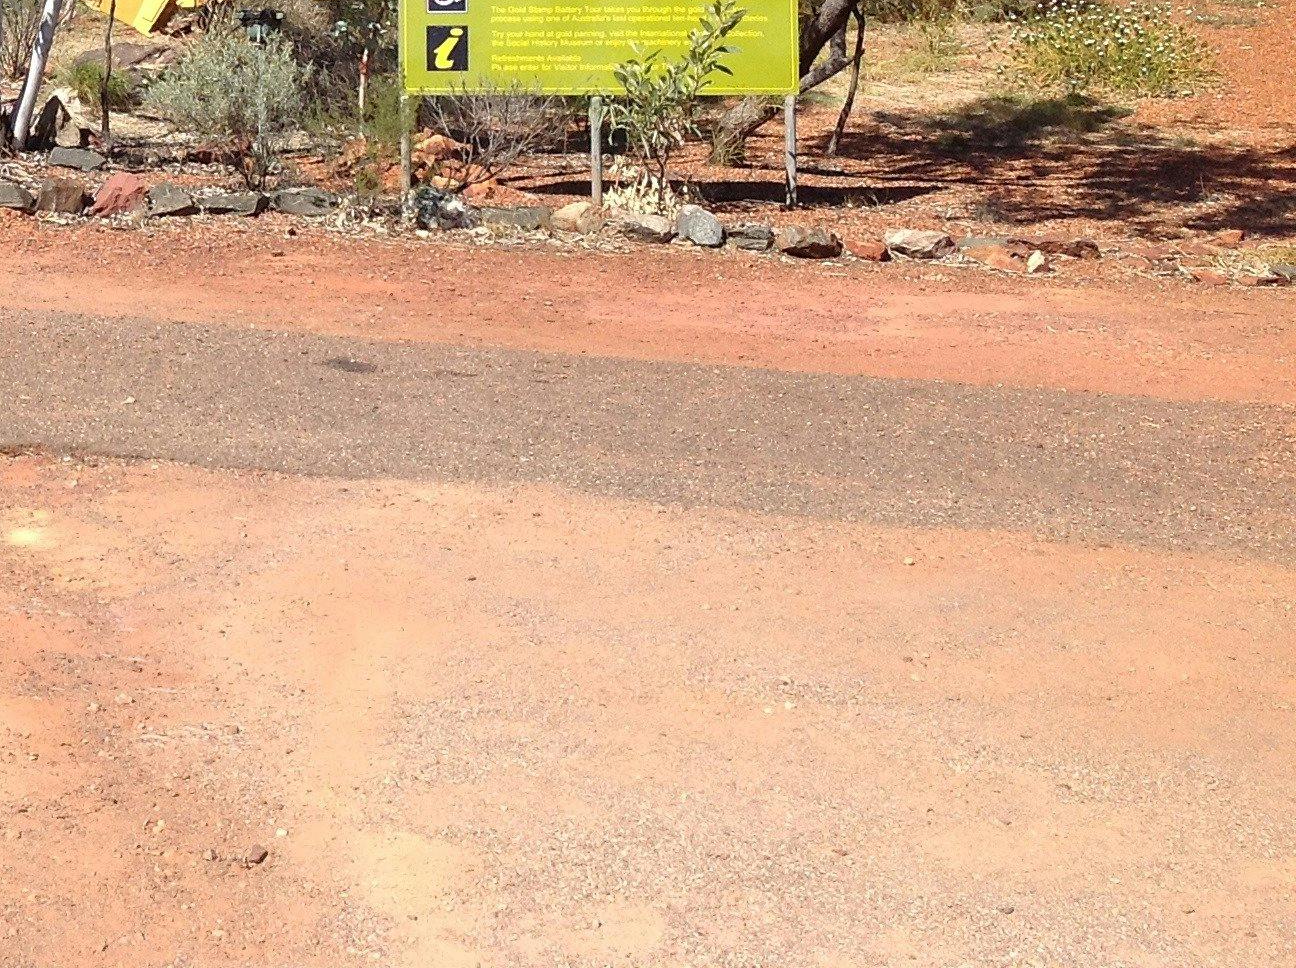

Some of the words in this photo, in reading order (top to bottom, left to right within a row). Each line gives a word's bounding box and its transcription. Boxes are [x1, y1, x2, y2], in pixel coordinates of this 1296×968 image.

[491, 5, 506, 13] The
[673, 5, 686, 13] the
[491, 30, 504, 39] Try
